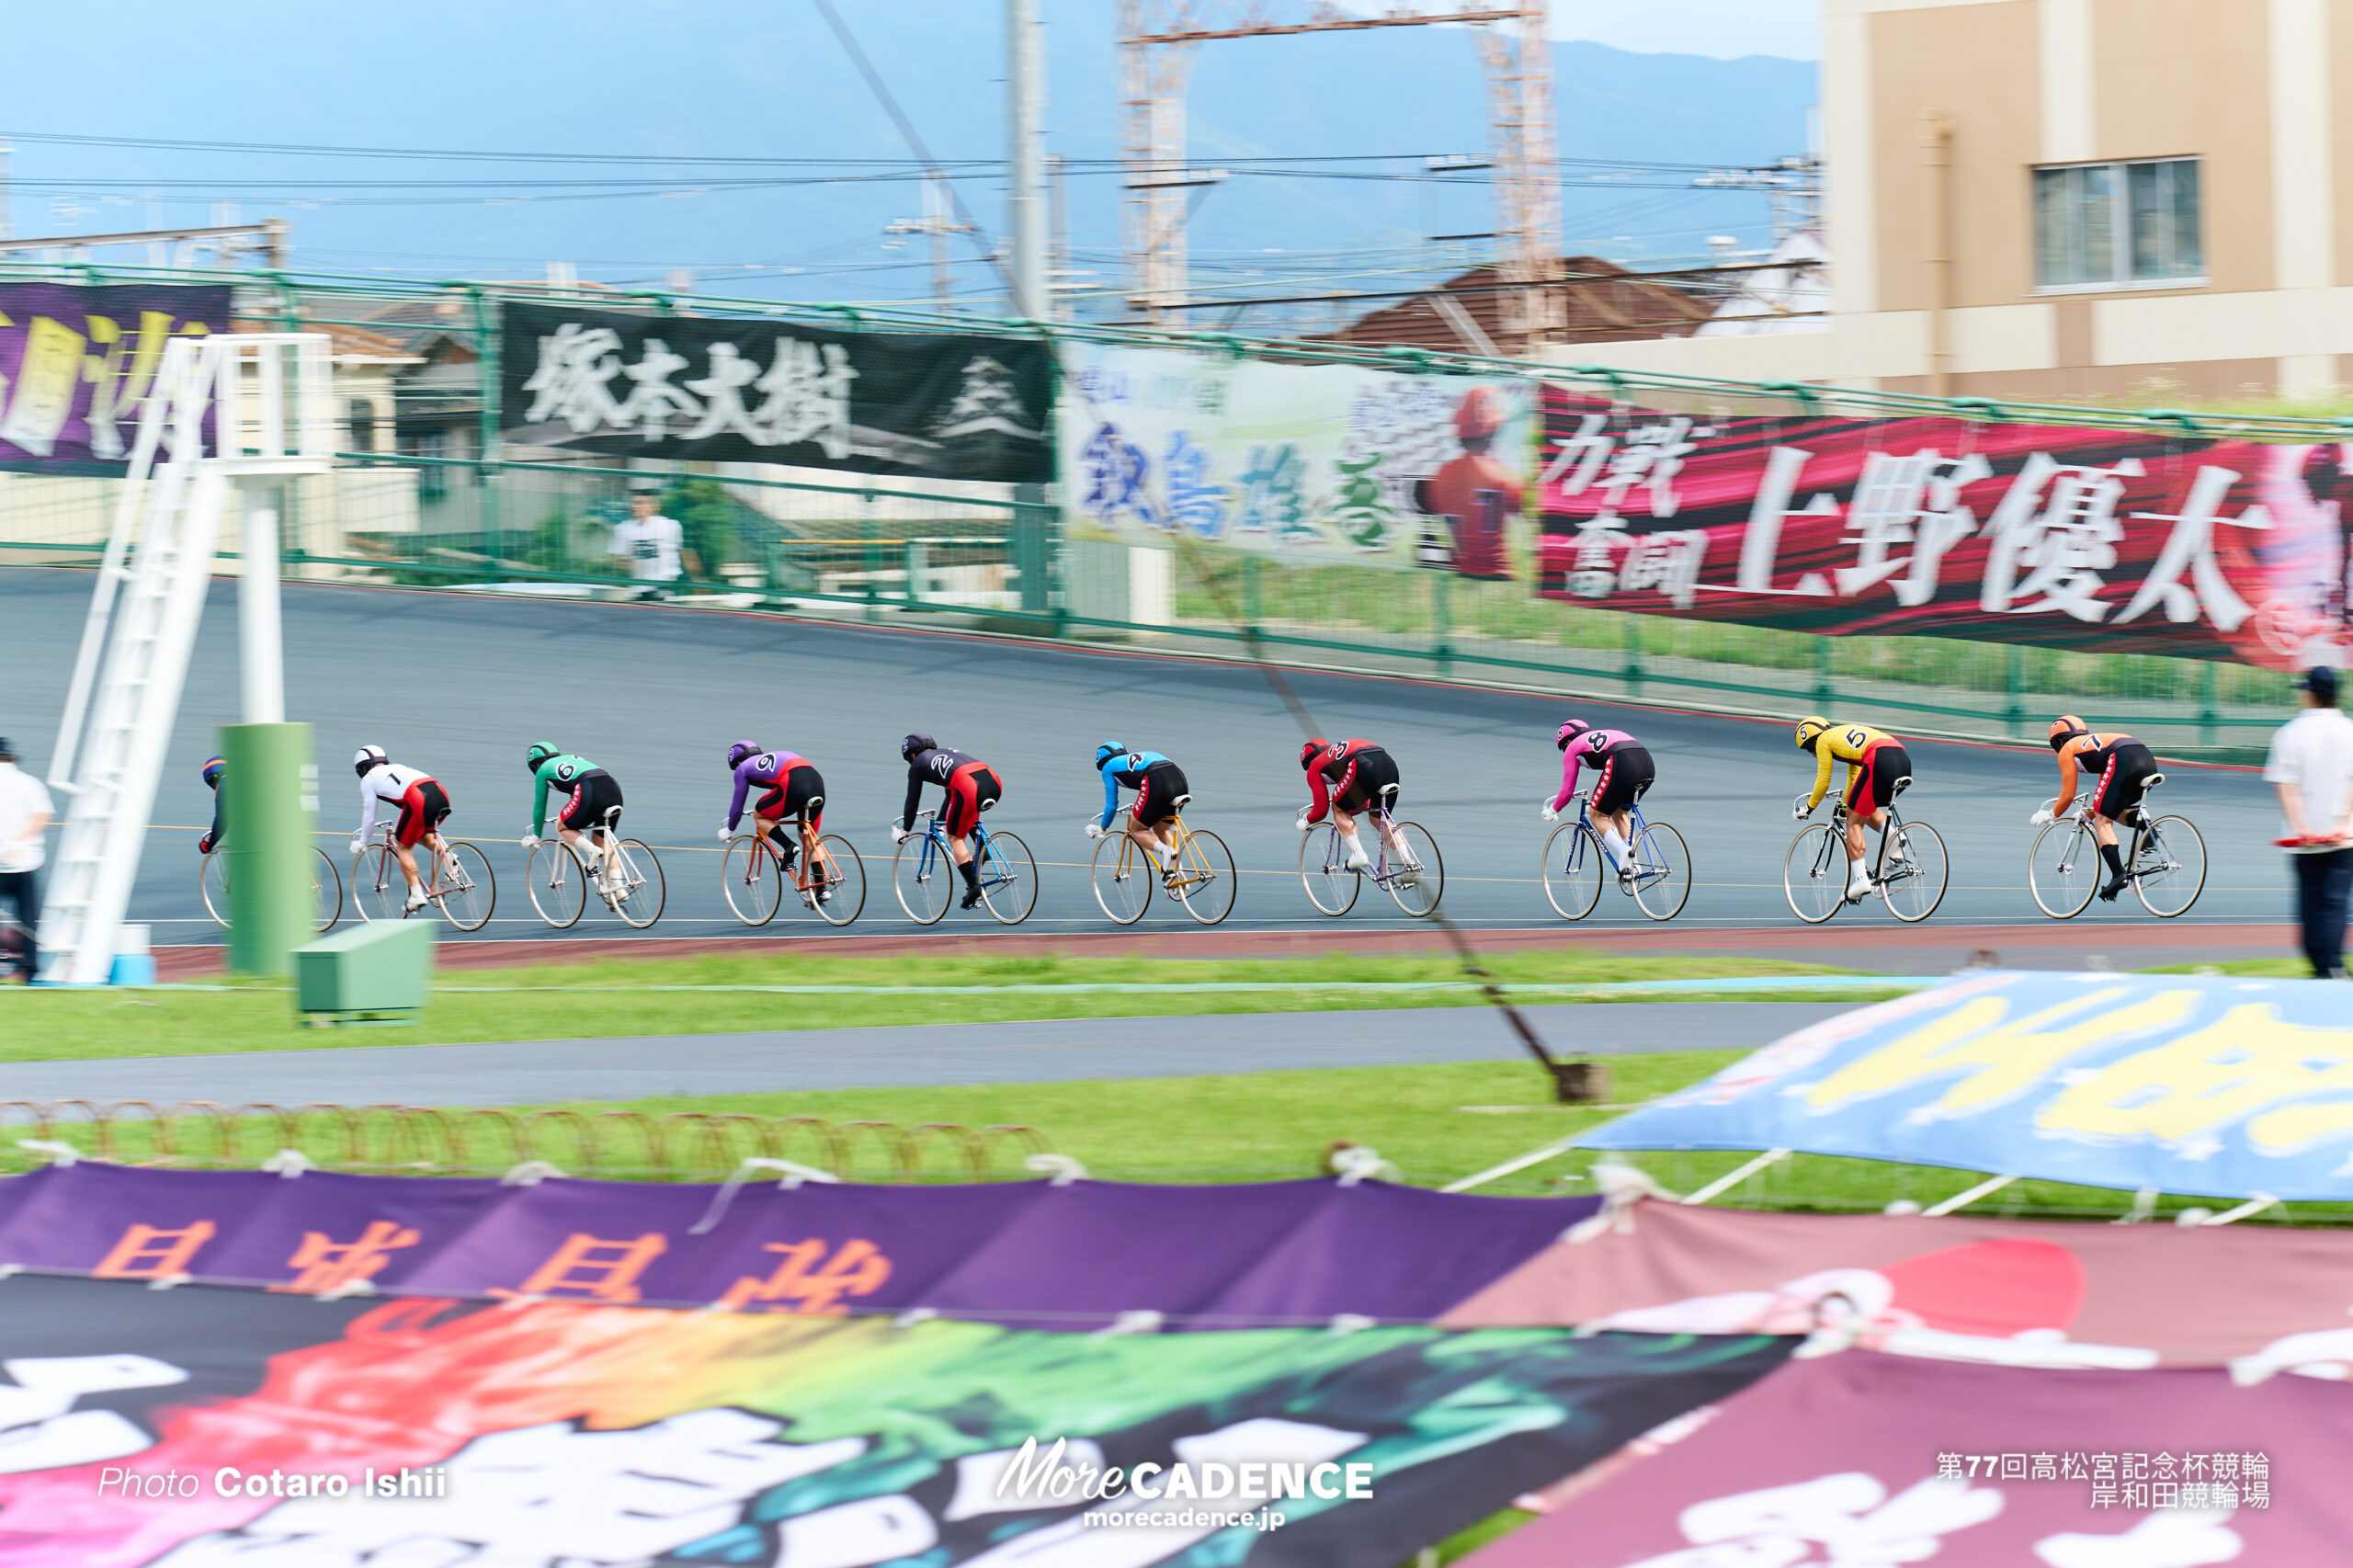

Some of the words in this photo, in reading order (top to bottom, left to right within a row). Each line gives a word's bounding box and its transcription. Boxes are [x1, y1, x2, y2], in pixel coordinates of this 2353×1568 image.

[522, 323, 860, 460] 塚本大樹
[1697, 446, 2276, 632] 上野優太
[1586, 732, 1608, 753] 8
[1799, 724, 1809, 741] 5
[1846, 728, 1868, 749] 5
[2081, 733, 2103, 752] 7
[1328, 741, 1349, 760] 3
[555, 761, 576, 782] 6
[756, 753, 777, 773] 9
[930, 754, 954, 779] 2
[1128, 752, 1146, 772] 4
[386, 772, 401, 786] 1
